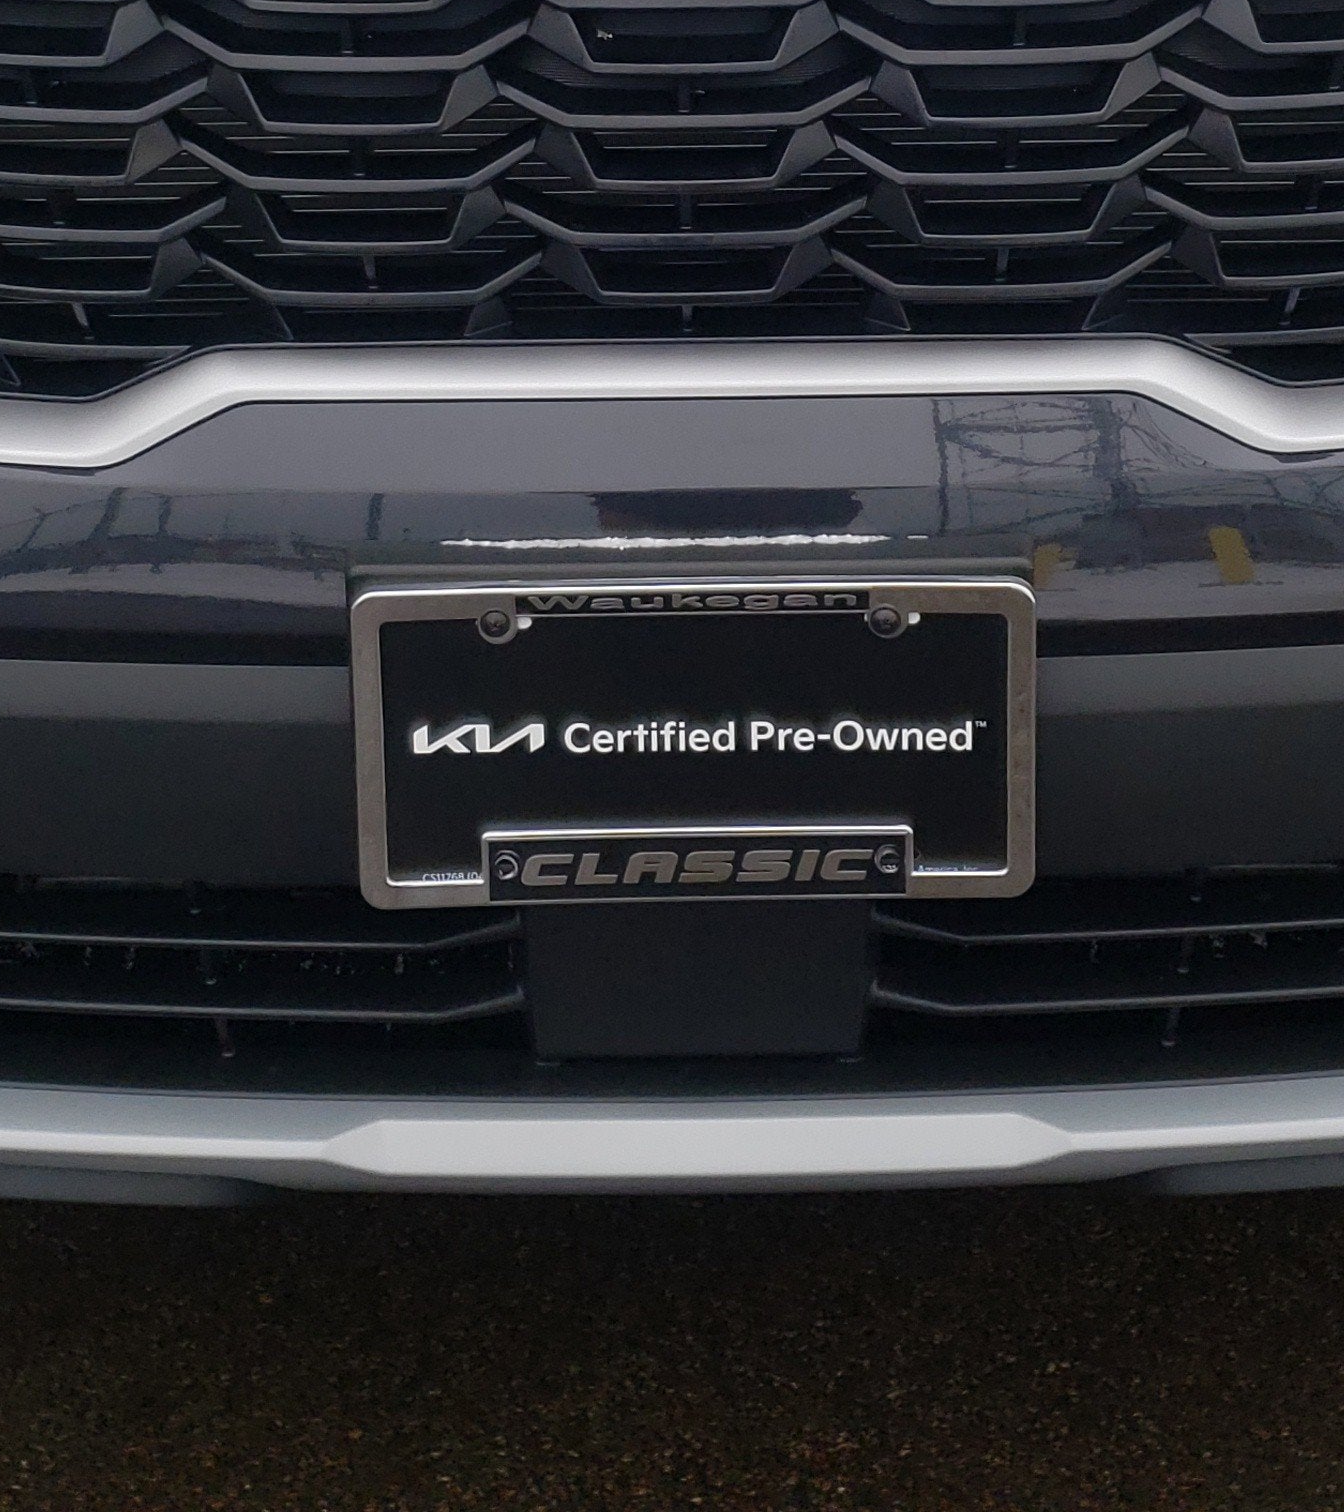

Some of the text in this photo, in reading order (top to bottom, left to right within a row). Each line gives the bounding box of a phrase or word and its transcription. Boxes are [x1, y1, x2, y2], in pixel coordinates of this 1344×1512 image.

[528, 593, 858, 611] Waukegan
[412, 723, 546, 754] KIA
[563, 721, 736, 754] Certified
[520, 848, 876, 887] CLASSIC
